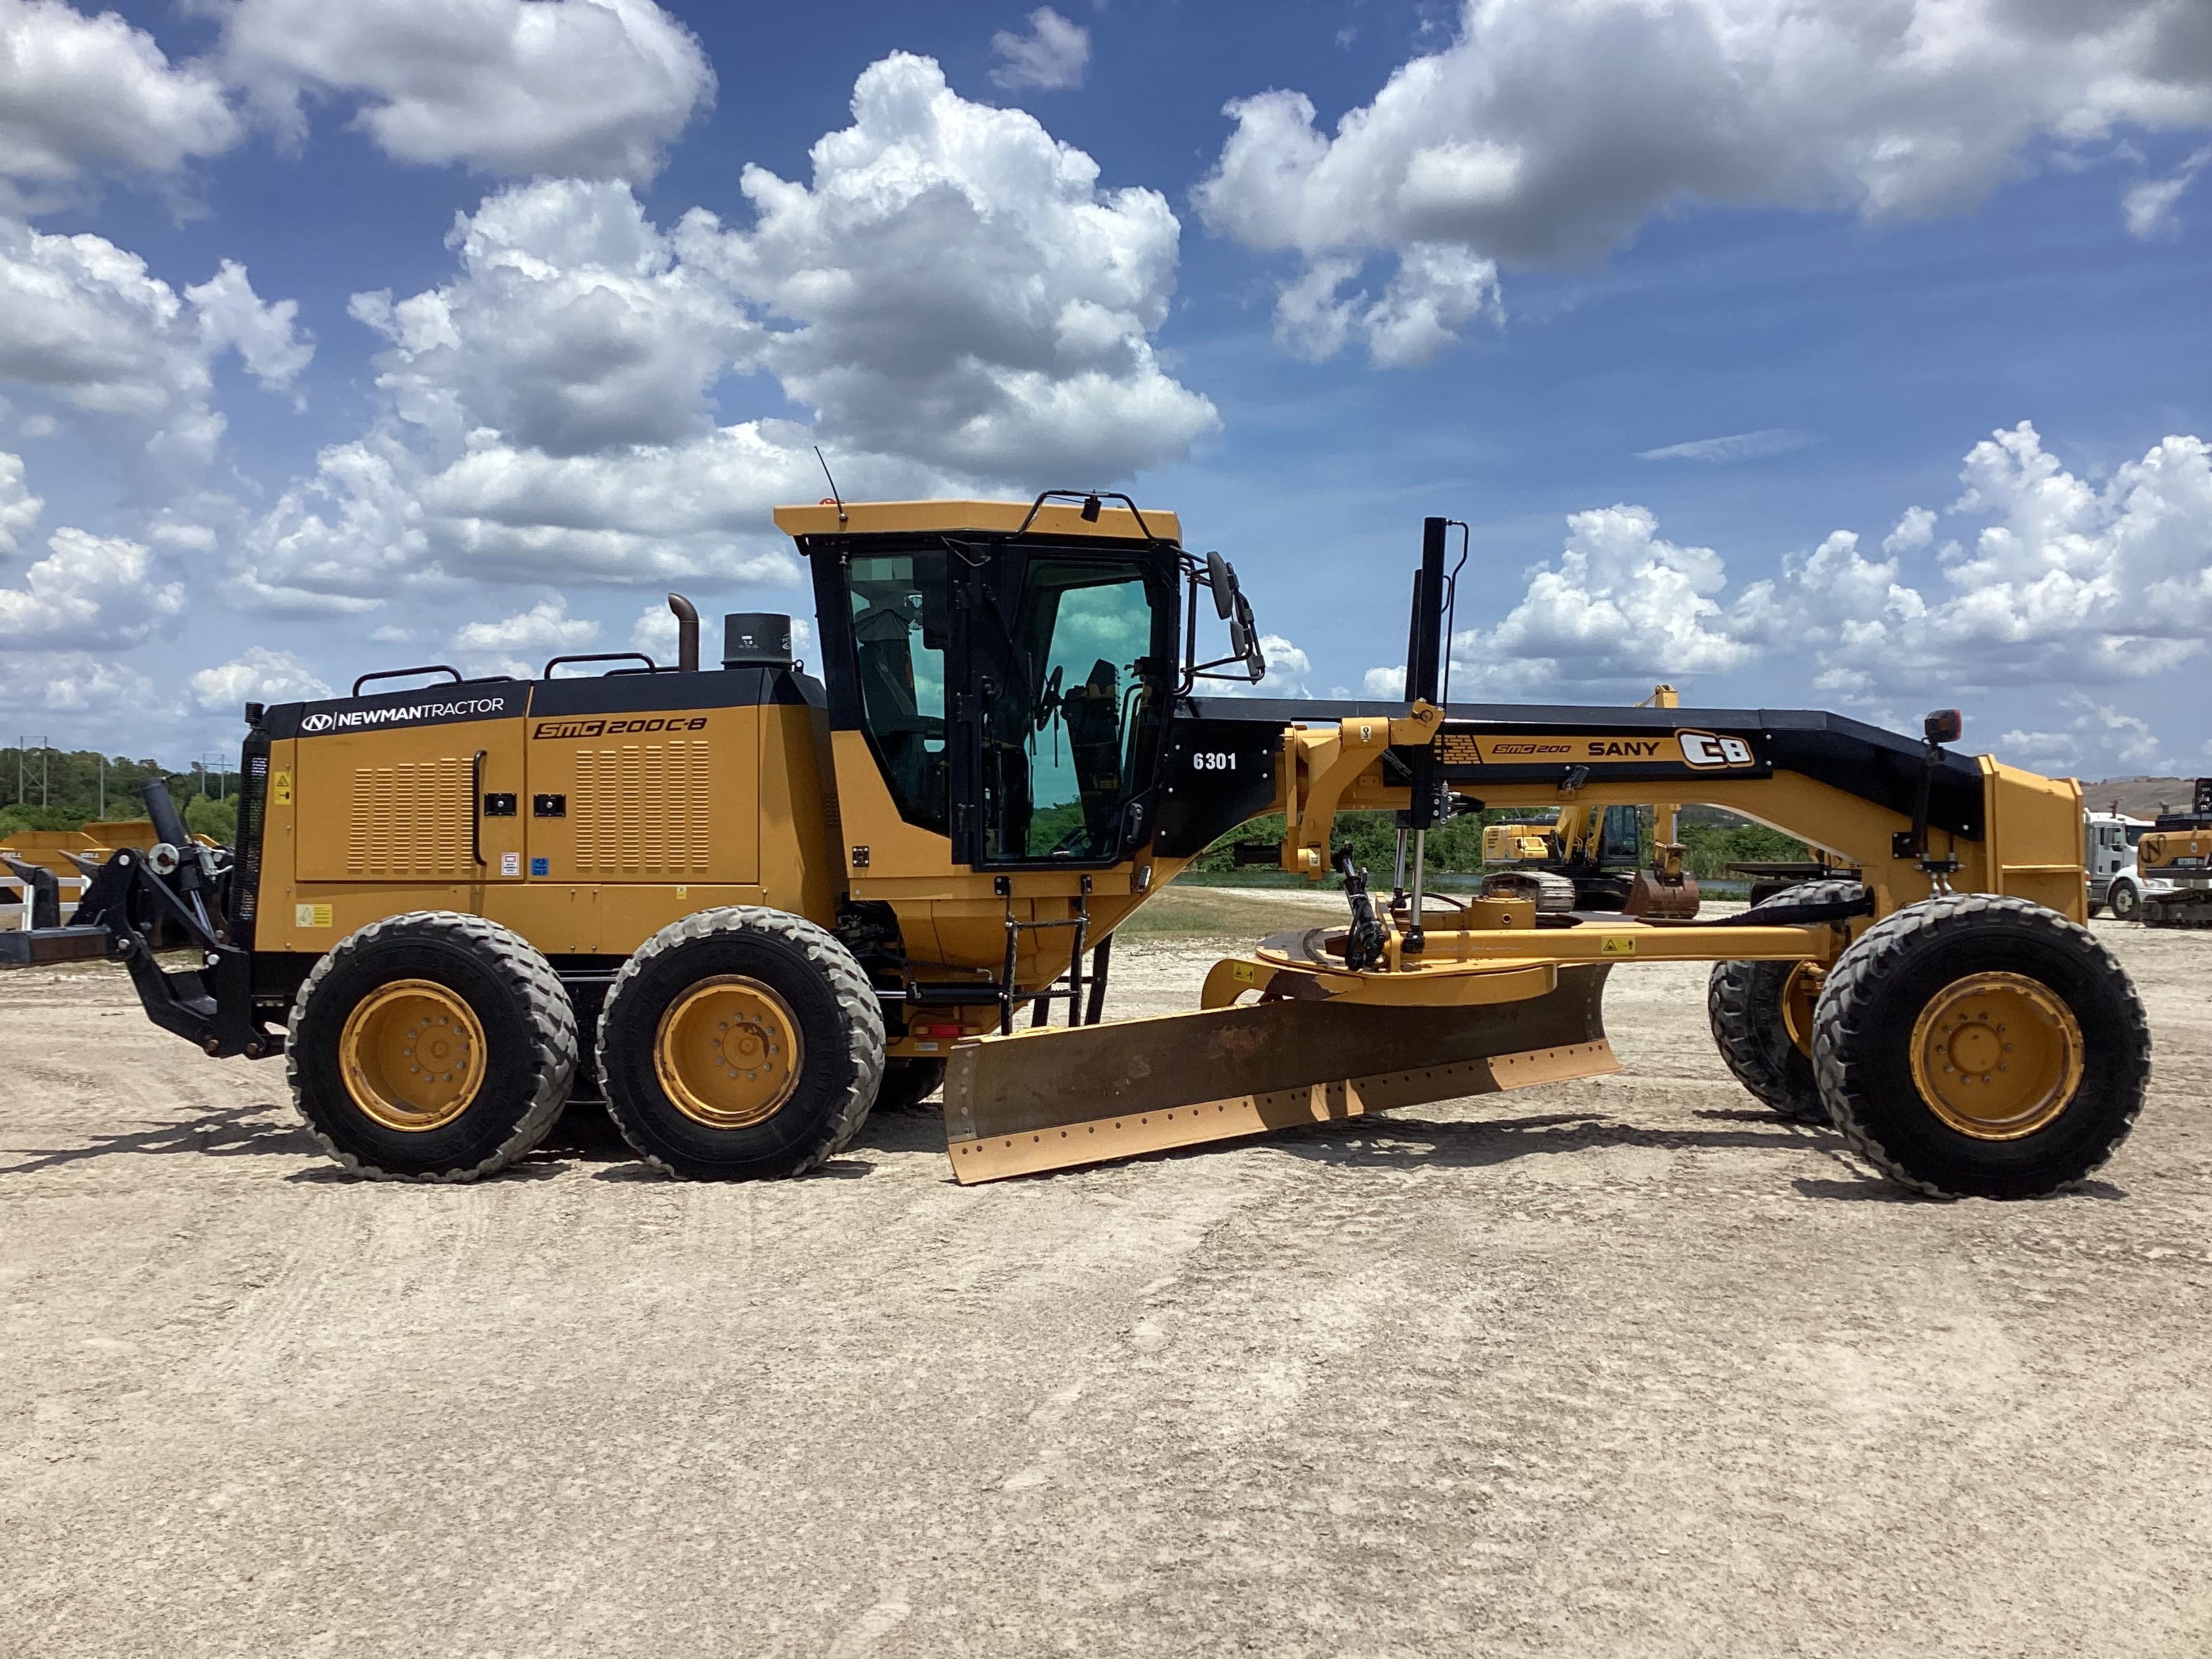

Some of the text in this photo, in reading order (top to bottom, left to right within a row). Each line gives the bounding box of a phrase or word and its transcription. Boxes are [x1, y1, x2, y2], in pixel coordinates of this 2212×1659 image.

[338, 697, 504, 726] NEWMANTRACTOR
[536, 721, 604, 739] SMG
[1494, 744, 1535, 754] SMG
[1588, 741, 1661, 756] SANY
[1193, 752, 1236, 769] 6301
